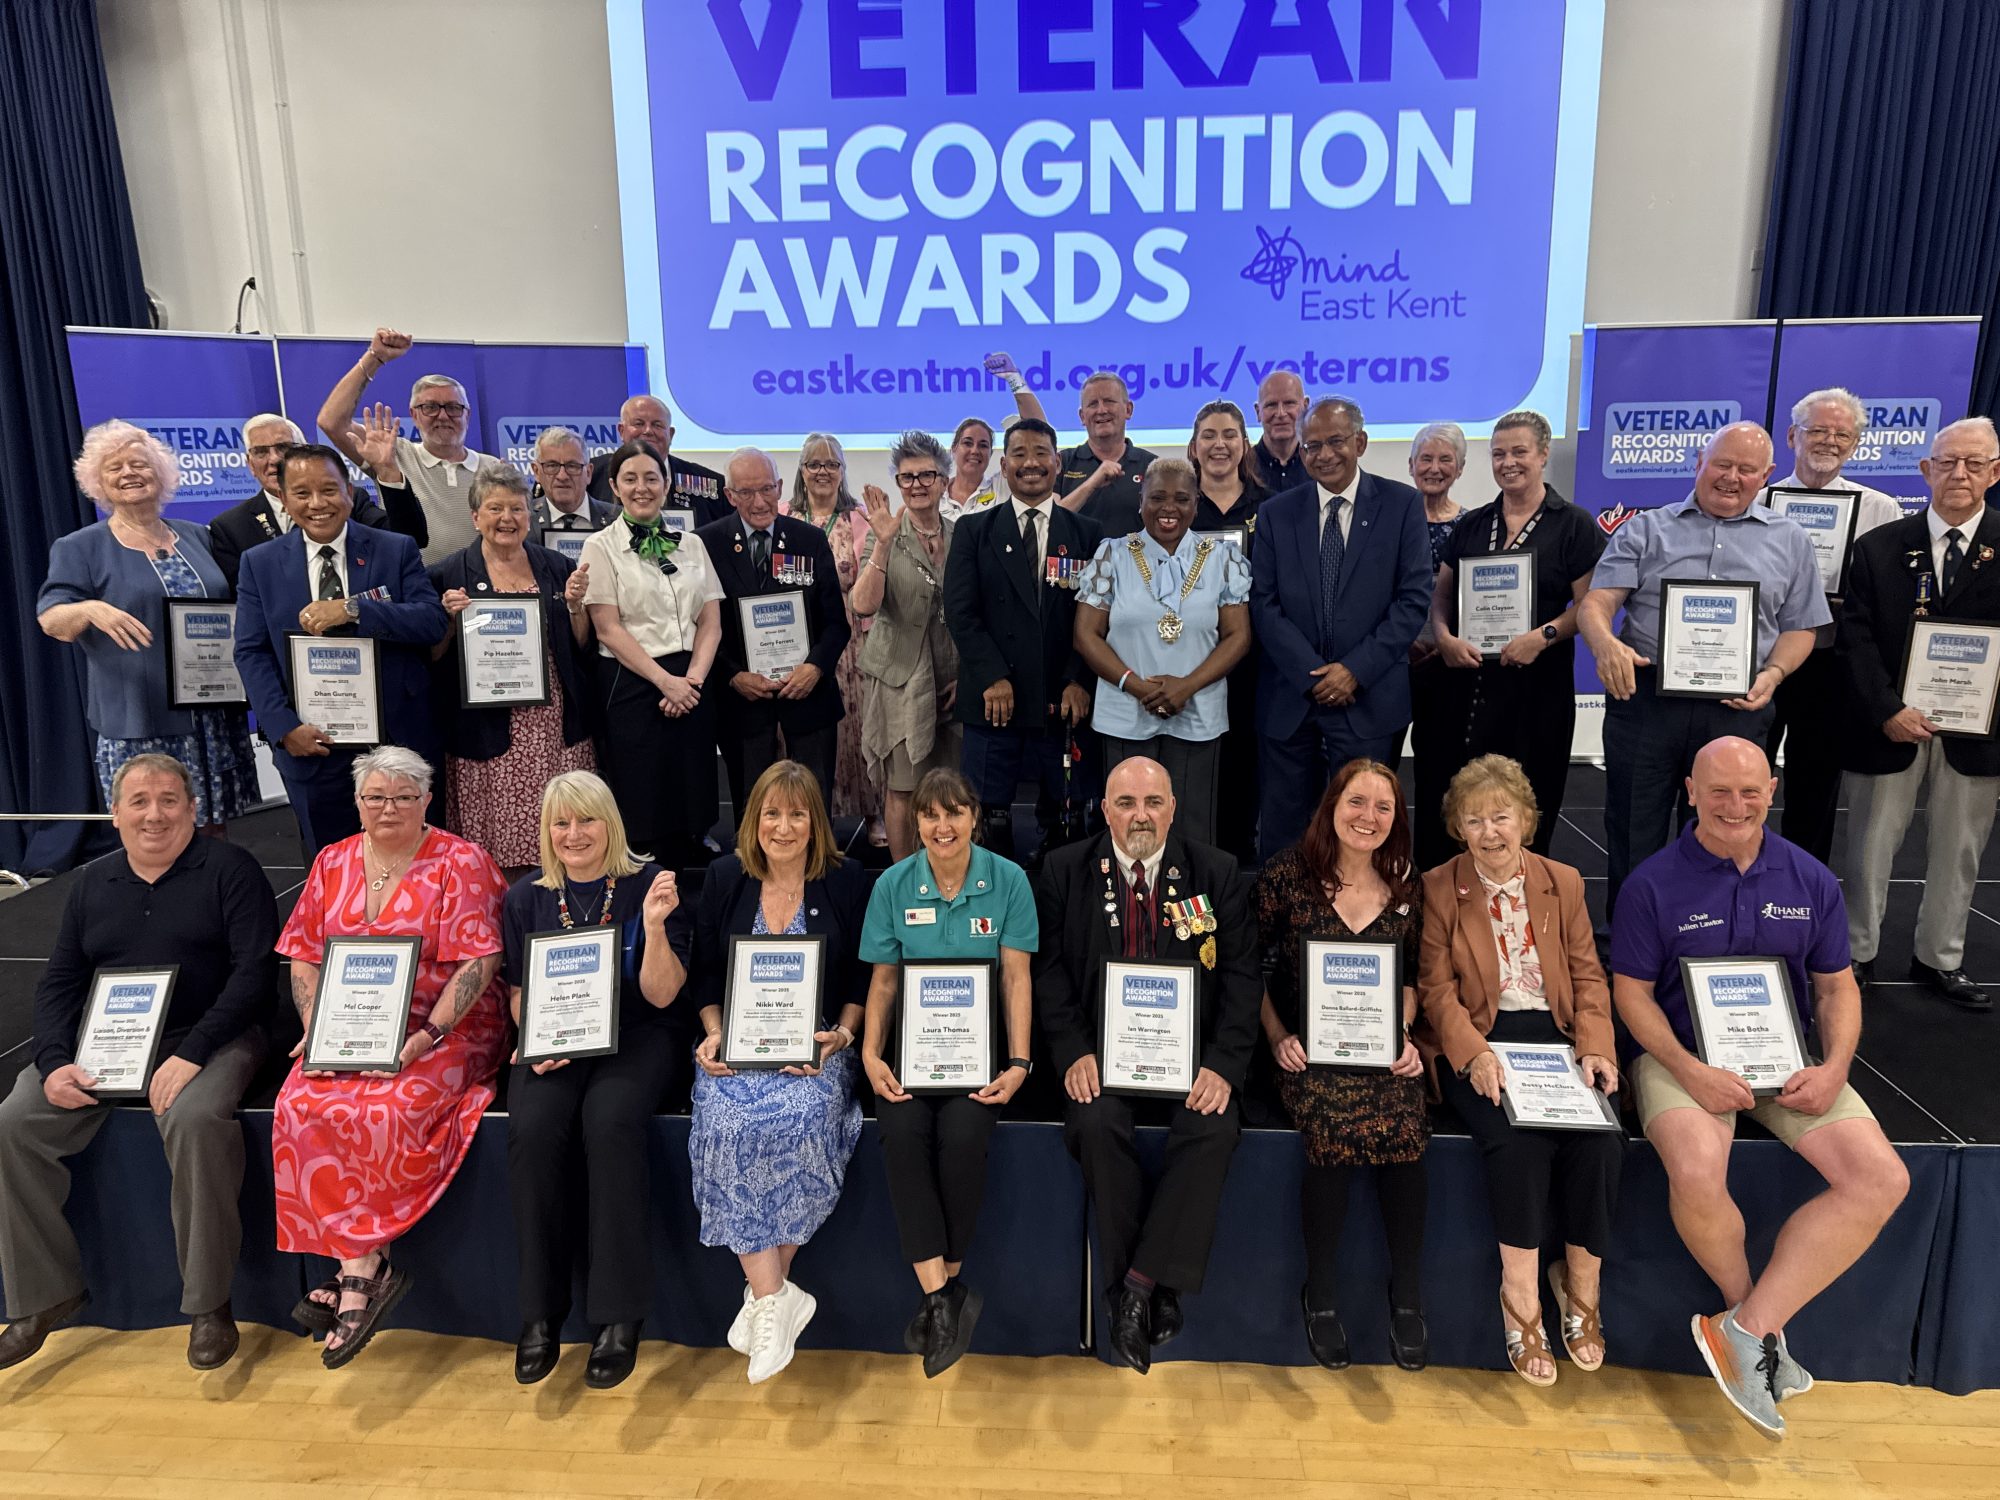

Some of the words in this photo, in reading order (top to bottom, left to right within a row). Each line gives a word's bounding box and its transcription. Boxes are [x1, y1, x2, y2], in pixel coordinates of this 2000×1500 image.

[704, 0, 1480, 103] VETERAN
[706, 108, 1476, 225] RECOGNITION
[1302, 249, 1410, 284] mind
[708, 227, 1191, 331] AWARDS
[1301, 290, 1375, 321] East
[1388, 288, 1467, 319] Kent
[1613, 409, 1730, 431] VETERAN
[1611, 433, 1716, 449] RECOGNITIO
[1609, 449, 1685, 464] AWARDS
[1790, 506, 1833, 514] VETERAN
[1476, 566, 1515, 576] VETERAN
[1686, 598, 1732, 608] VETERAN
[756, 604, 790, 614] VETERAN
[188, 616, 226, 624] VETERAN
[1932, 636, 1985, 646] VETERAN
[310, 650, 356, 658] VETERAN
[1772, 906, 1811, 915] THANET
[1689, 913, 1709, 922] Chair
[1678, 923, 1699, 933] Julien
[1699, 919, 1725, 928] Lawton
[550, 946, 596, 960] VETERAN
[348, 958, 394, 966] VETERAN
[548, 956, 596, 966] RECOGNITION
[754, 956, 801, 964] VETERAN
[1326, 956, 1375, 966] VETERAN
[548, 964, 578, 972] AWARDS
[1326, 966, 1375, 974] RECOGNITION
[924, 980, 970, 988] VETERAN
[1126, 978, 1173, 990] VETERAN
[1710, 976, 1763, 988] VETERAN
[112, 988, 153, 996] VETERAN
[924, 988, 970, 996] RECOGNITION
[1126, 988, 1173, 998] RECOGNITION
[1712, 986, 1765, 994] RECOGNITION
[572, 992, 590, 1000] Plank
[1124, 994, 1156, 1002] AWARDS
[1138, 1026, 1171, 1034] Warrington
